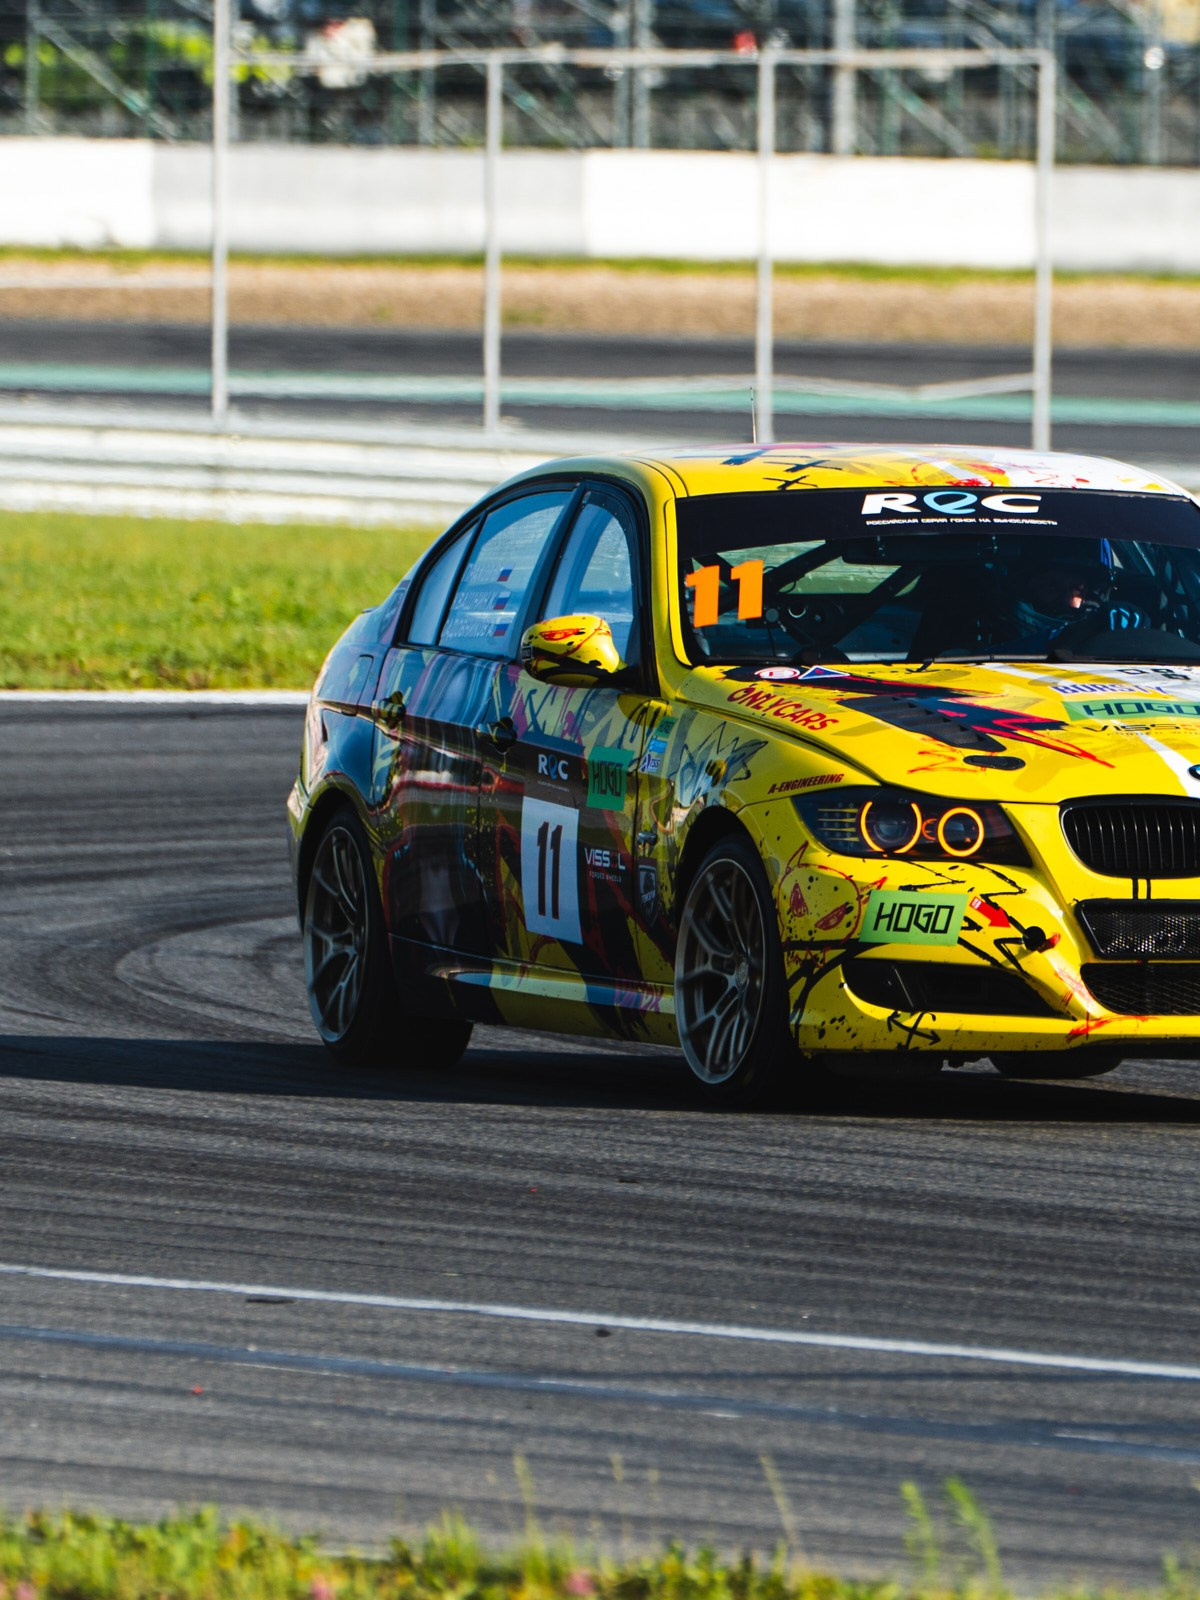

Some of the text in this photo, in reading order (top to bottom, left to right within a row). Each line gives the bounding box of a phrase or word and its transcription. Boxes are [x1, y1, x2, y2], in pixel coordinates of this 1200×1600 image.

[686, 560, 764, 628] 11
[727, 687, 840, 731] ONLYCARS
[592, 760, 624, 797] HOGO
[768, 773, 844, 795] A-ENGINEERING
[536, 821, 563, 920] 11
[873, 902, 955, 935] HOGO
